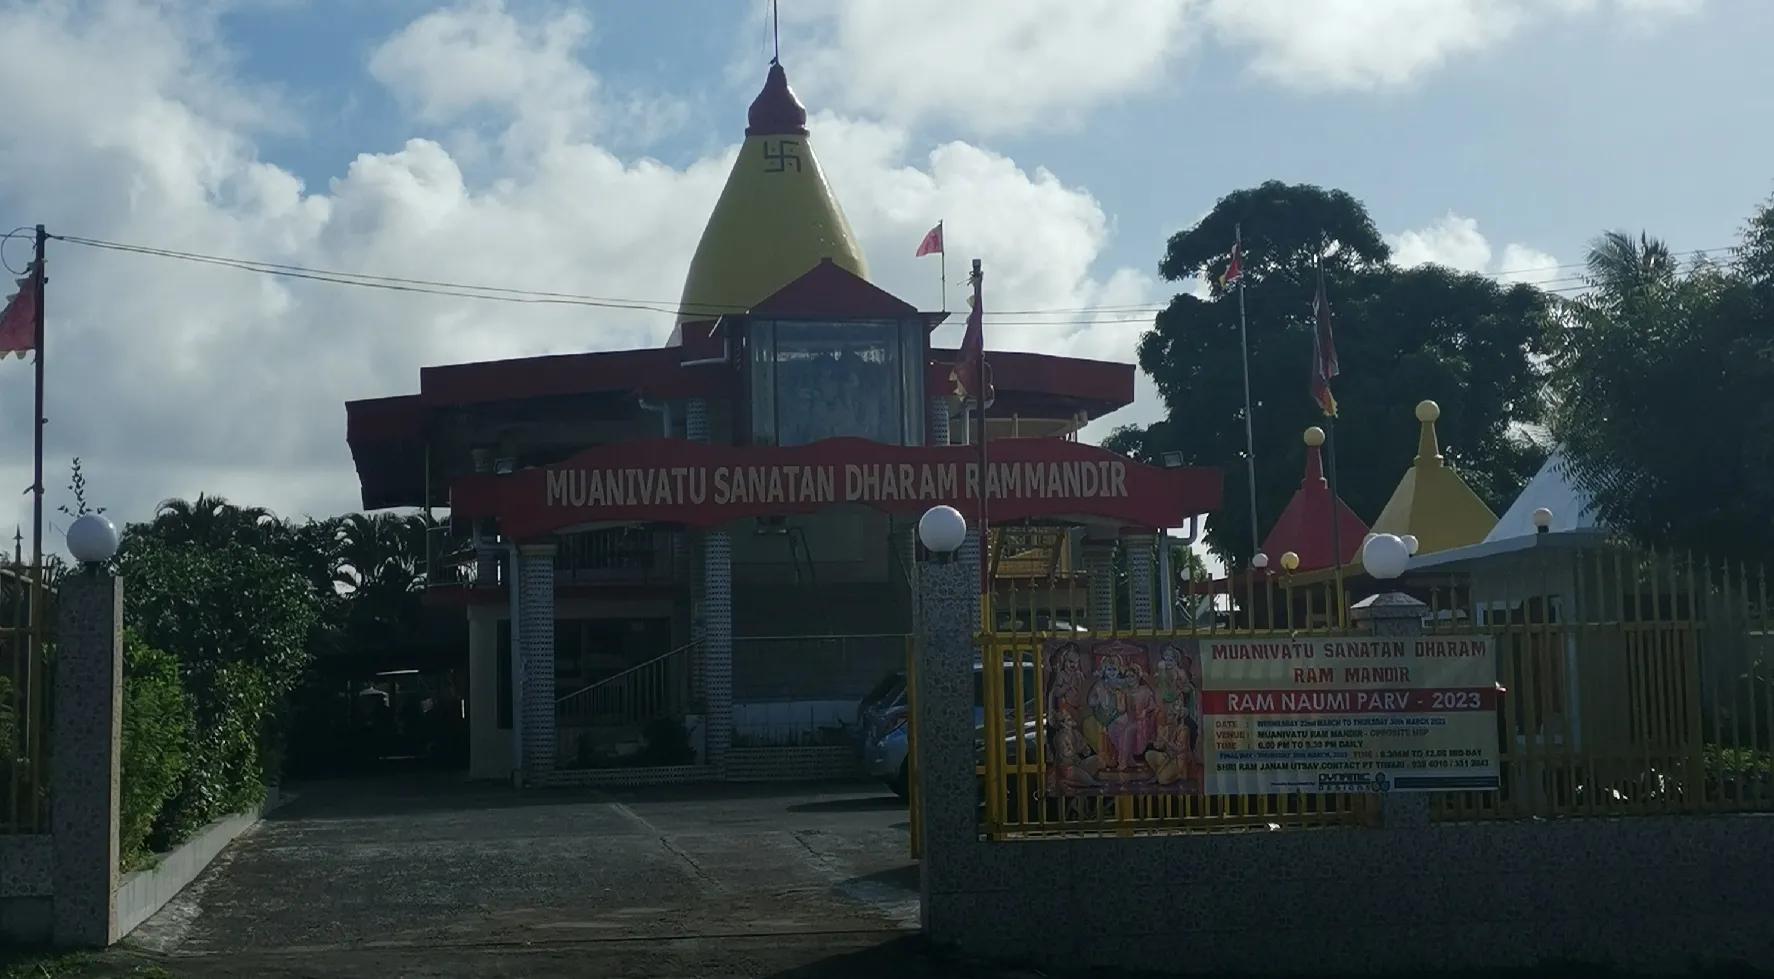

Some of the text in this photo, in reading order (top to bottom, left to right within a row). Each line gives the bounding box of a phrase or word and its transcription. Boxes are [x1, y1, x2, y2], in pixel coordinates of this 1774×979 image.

[546, 467, 706, 506] MUANIVATU
[714, 465, 834, 504] SANATAN
[845, 463, 958, 501] DHARAM
[1211, 640, 1486, 660] MUANIVATU SANATAN DHARAM
[1294, 666, 1410, 683] RAM MANDIR
[1228, 692, 1275, 712] RAM
[1281, 692, 1350, 711] NAUMI
[1358, 691, 1410, 710] PARV
[1431, 691, 1481, 709] 2023
[1216, 720, 1237, 728] DATE
[1216, 731, 1245, 739] VENUE
[1257, 730, 1308, 738] MUANIVATU
[1216, 741, 1237, 749] TIME
[1276, 740, 1291, 749] PM
[1292, 740, 1303, 748] TO
[1411, 749, 1423, 757] TO
[1239, 762, 1257, 771] RAM
[1260, 762, 1288, 770] JANAM
